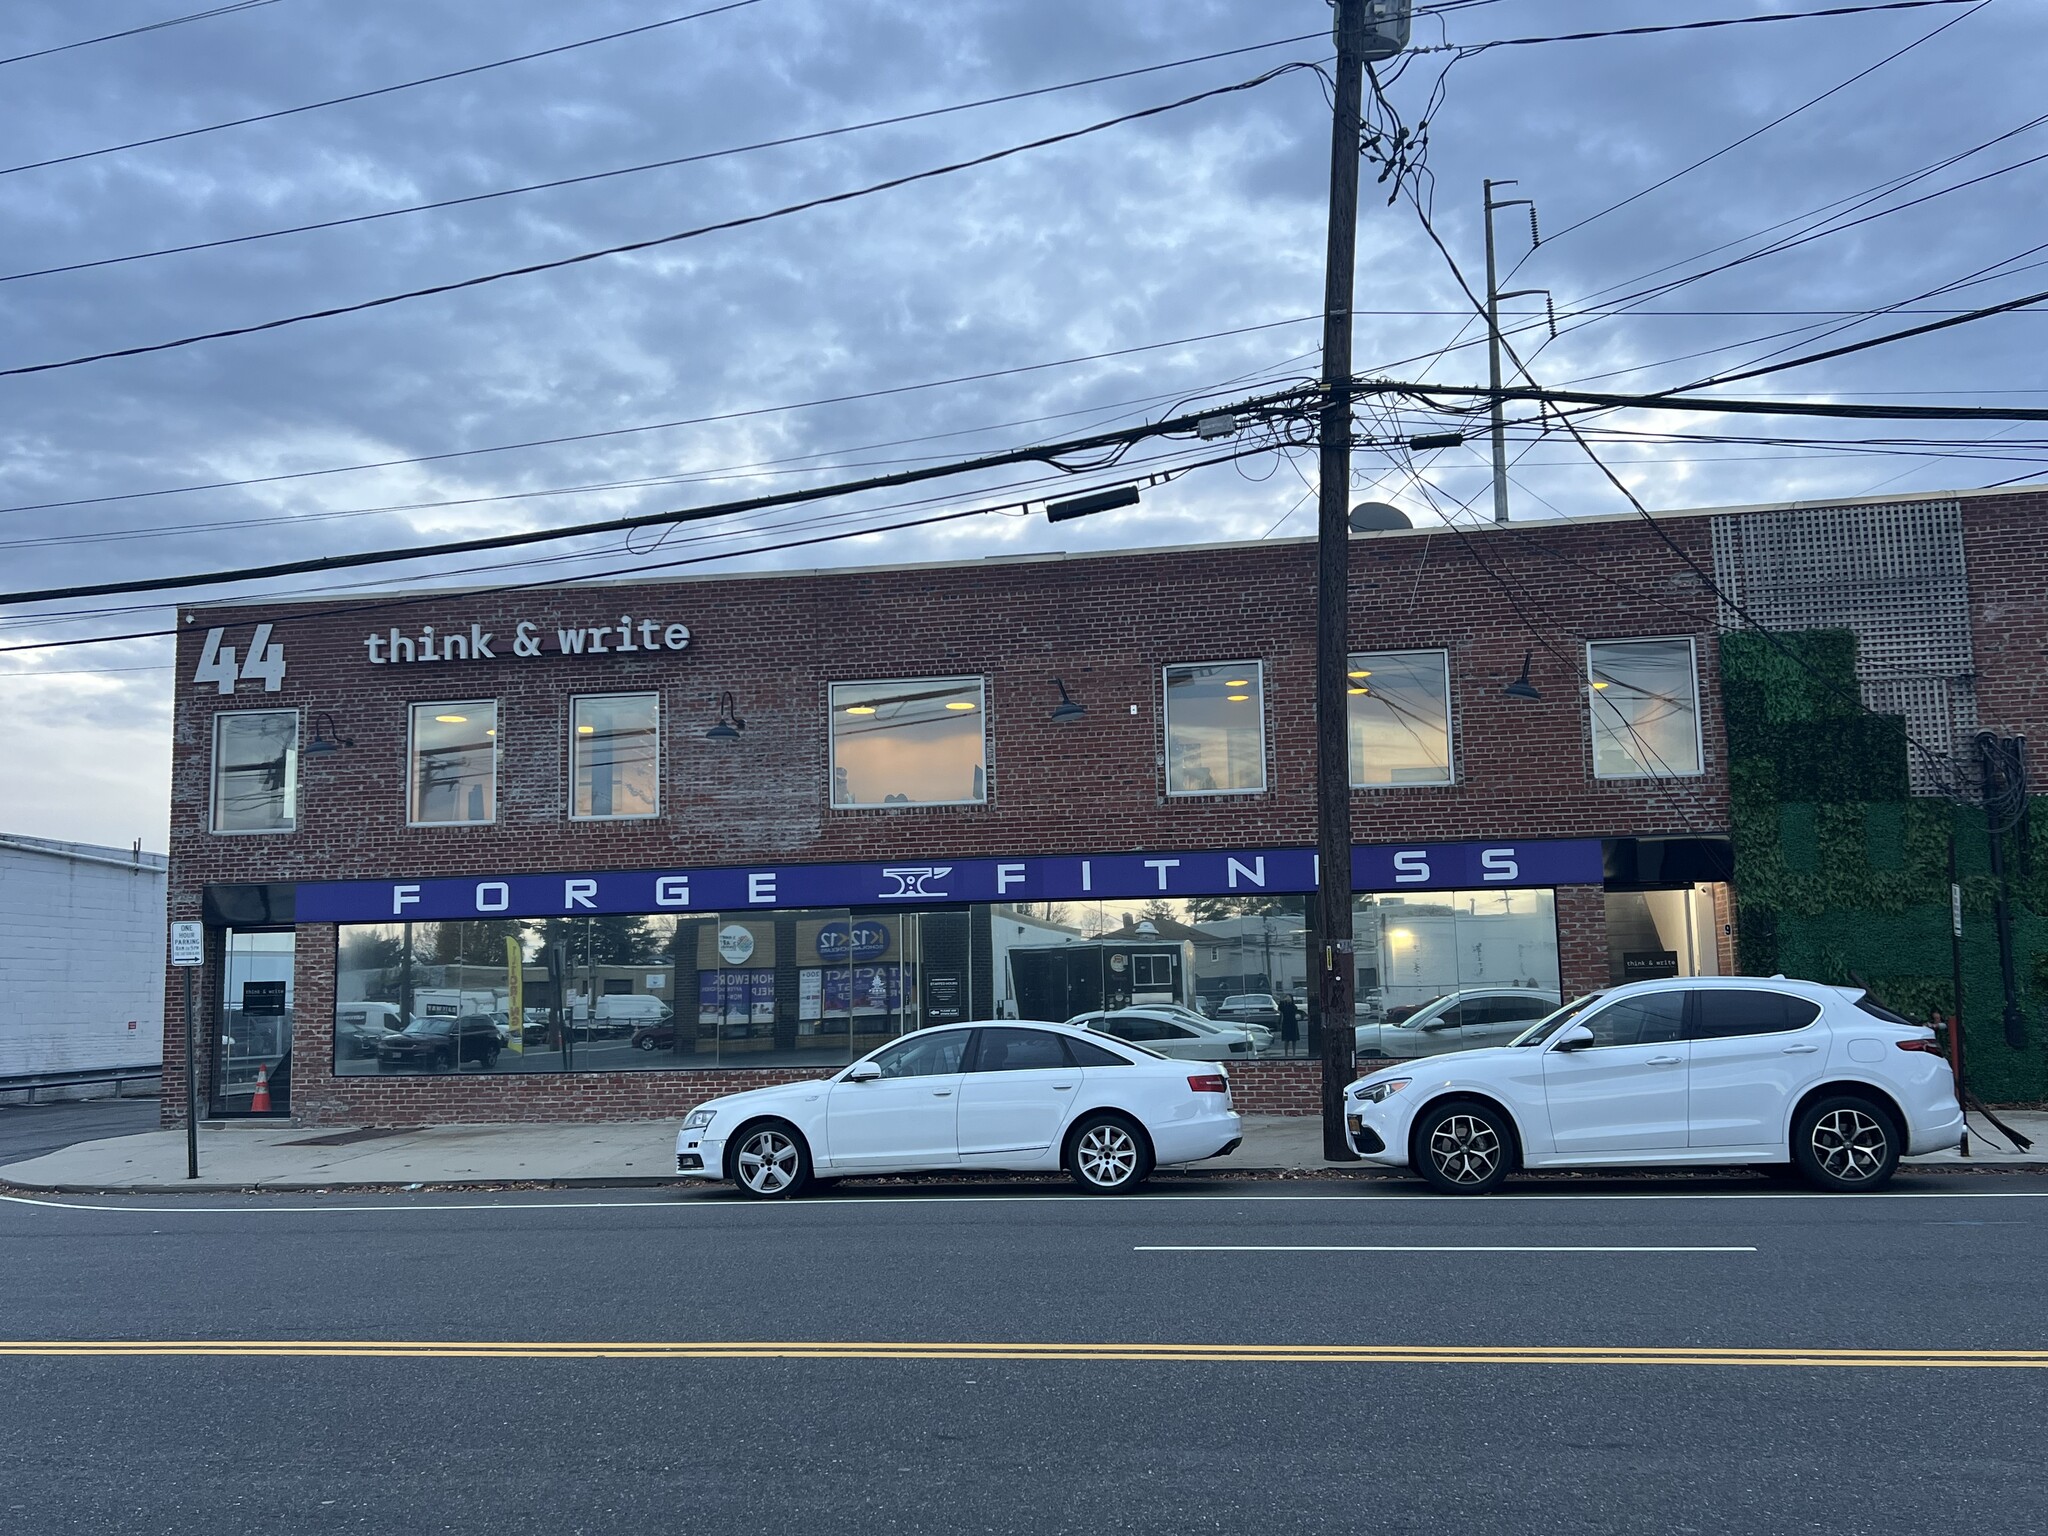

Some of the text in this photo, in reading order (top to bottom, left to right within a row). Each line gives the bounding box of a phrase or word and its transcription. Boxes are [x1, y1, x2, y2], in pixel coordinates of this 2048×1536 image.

[192, 623, 287, 695] 44
[363, 615, 690, 665] think & write
[393, 848, 1519, 915] FORGE FITNSS
[1725, 924, 1731, 935] 9
